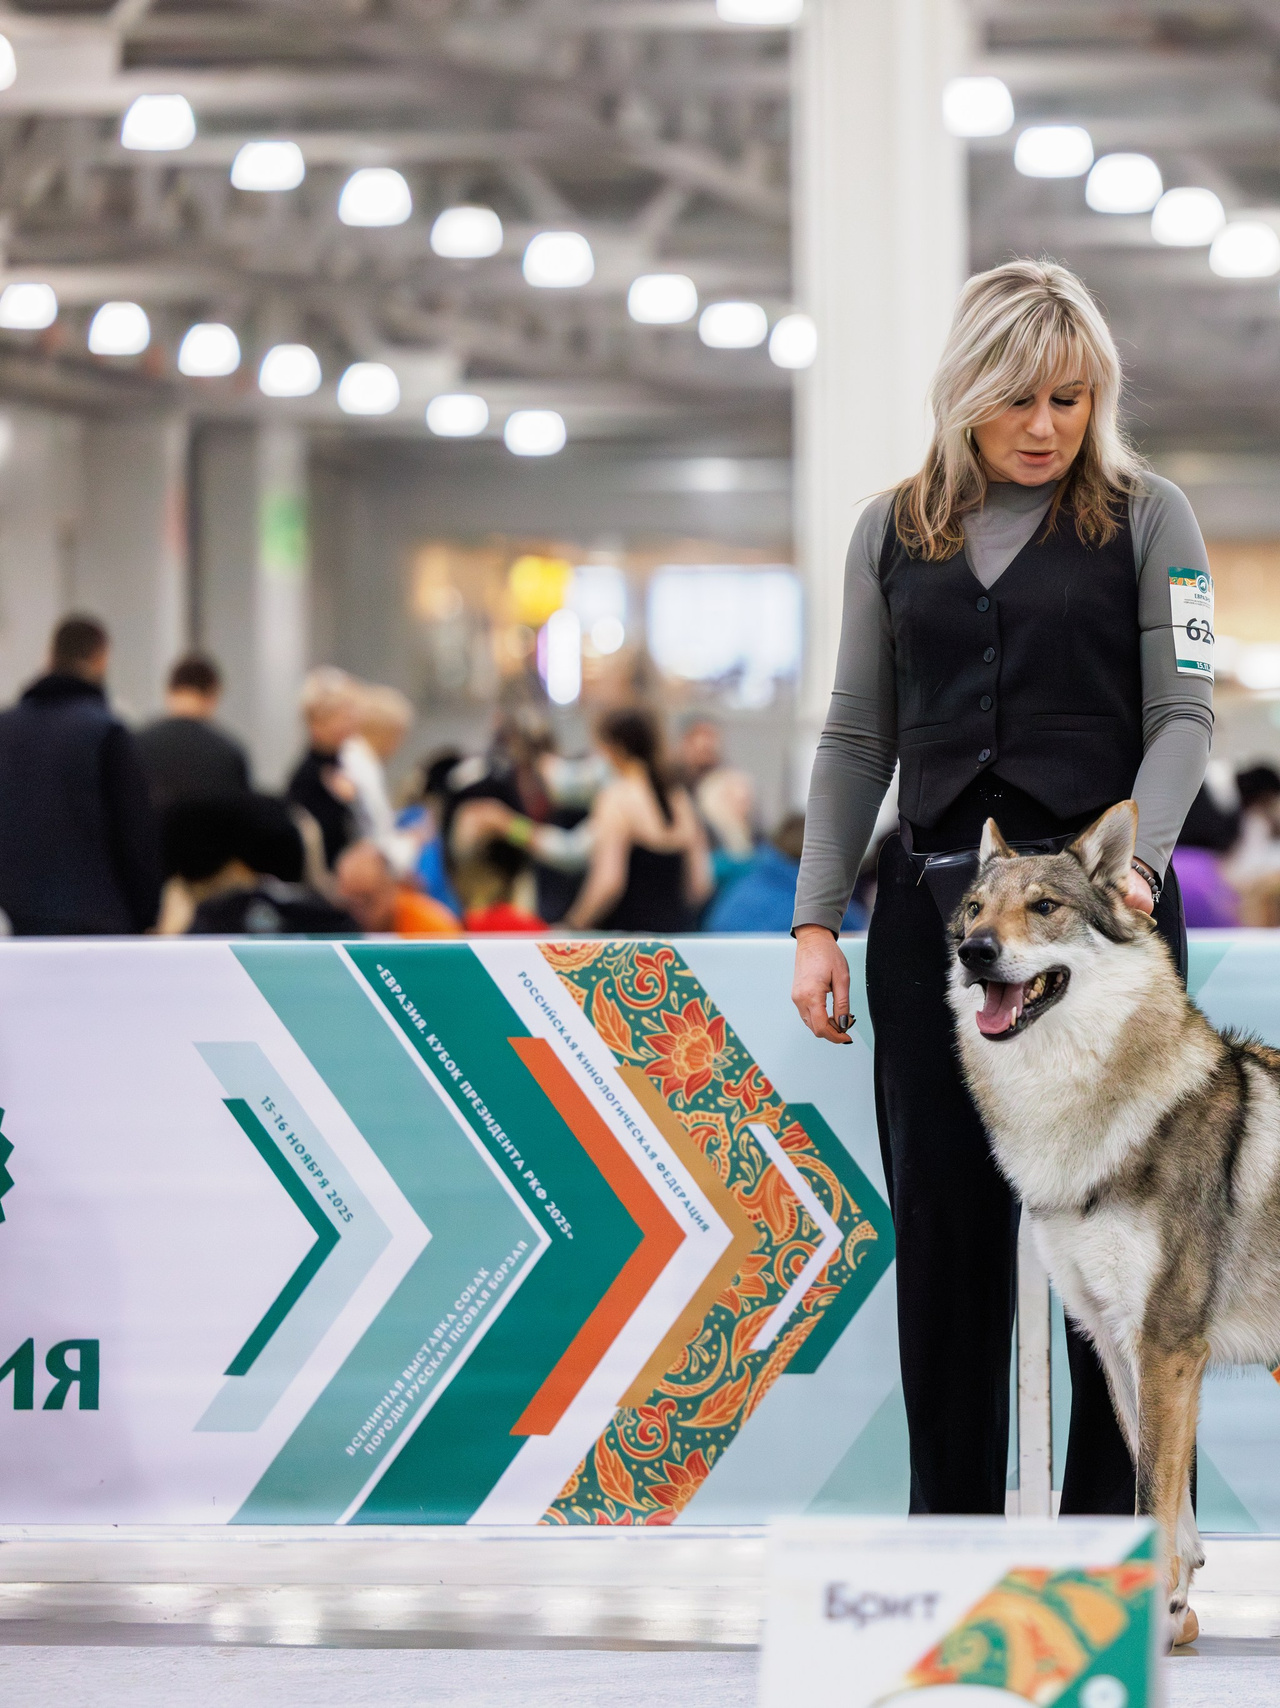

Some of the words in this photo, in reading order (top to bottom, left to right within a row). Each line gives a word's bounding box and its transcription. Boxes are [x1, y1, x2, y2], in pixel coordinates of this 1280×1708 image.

[261, 1096, 288, 1131] 15-16
[286, 1132, 330, 1189] НОЯБРЯ
[326, 1189, 354, 1223] 2025
[376, 963, 428, 1035] «ЕВРАЗИЯ.
[425, 1033, 463, 1082] КУБОК
[459, 1080, 525, 1171] ПРЕЗИДЕНТА
[523, 1170, 548, 1200] РКФ
[544, 1201, 574, 1240] 2025»
[518, 971, 578, 1050] РОССИЙСКАЯ
[576, 1051, 657, 1161] КИНОЛОГИЧЕСКАЯ
[656, 1162, 710, 1234] ФЕДЕРАЦИЯ
[345, 1379, 405, 1456] ВСЕМИРНАЯ
[402, 1313, 457, 1381] ВЫСТАВКА
[454, 1267, 490, 1312] СОБАК
[363, 1399, 408, 1455] ПОРОДЫ
[405, 1341, 452, 1401] РУССКАЯ
[449, 1289, 491, 1343] ПСОВАЯ
[487, 1239, 529, 1291] БОРЗАЯ
